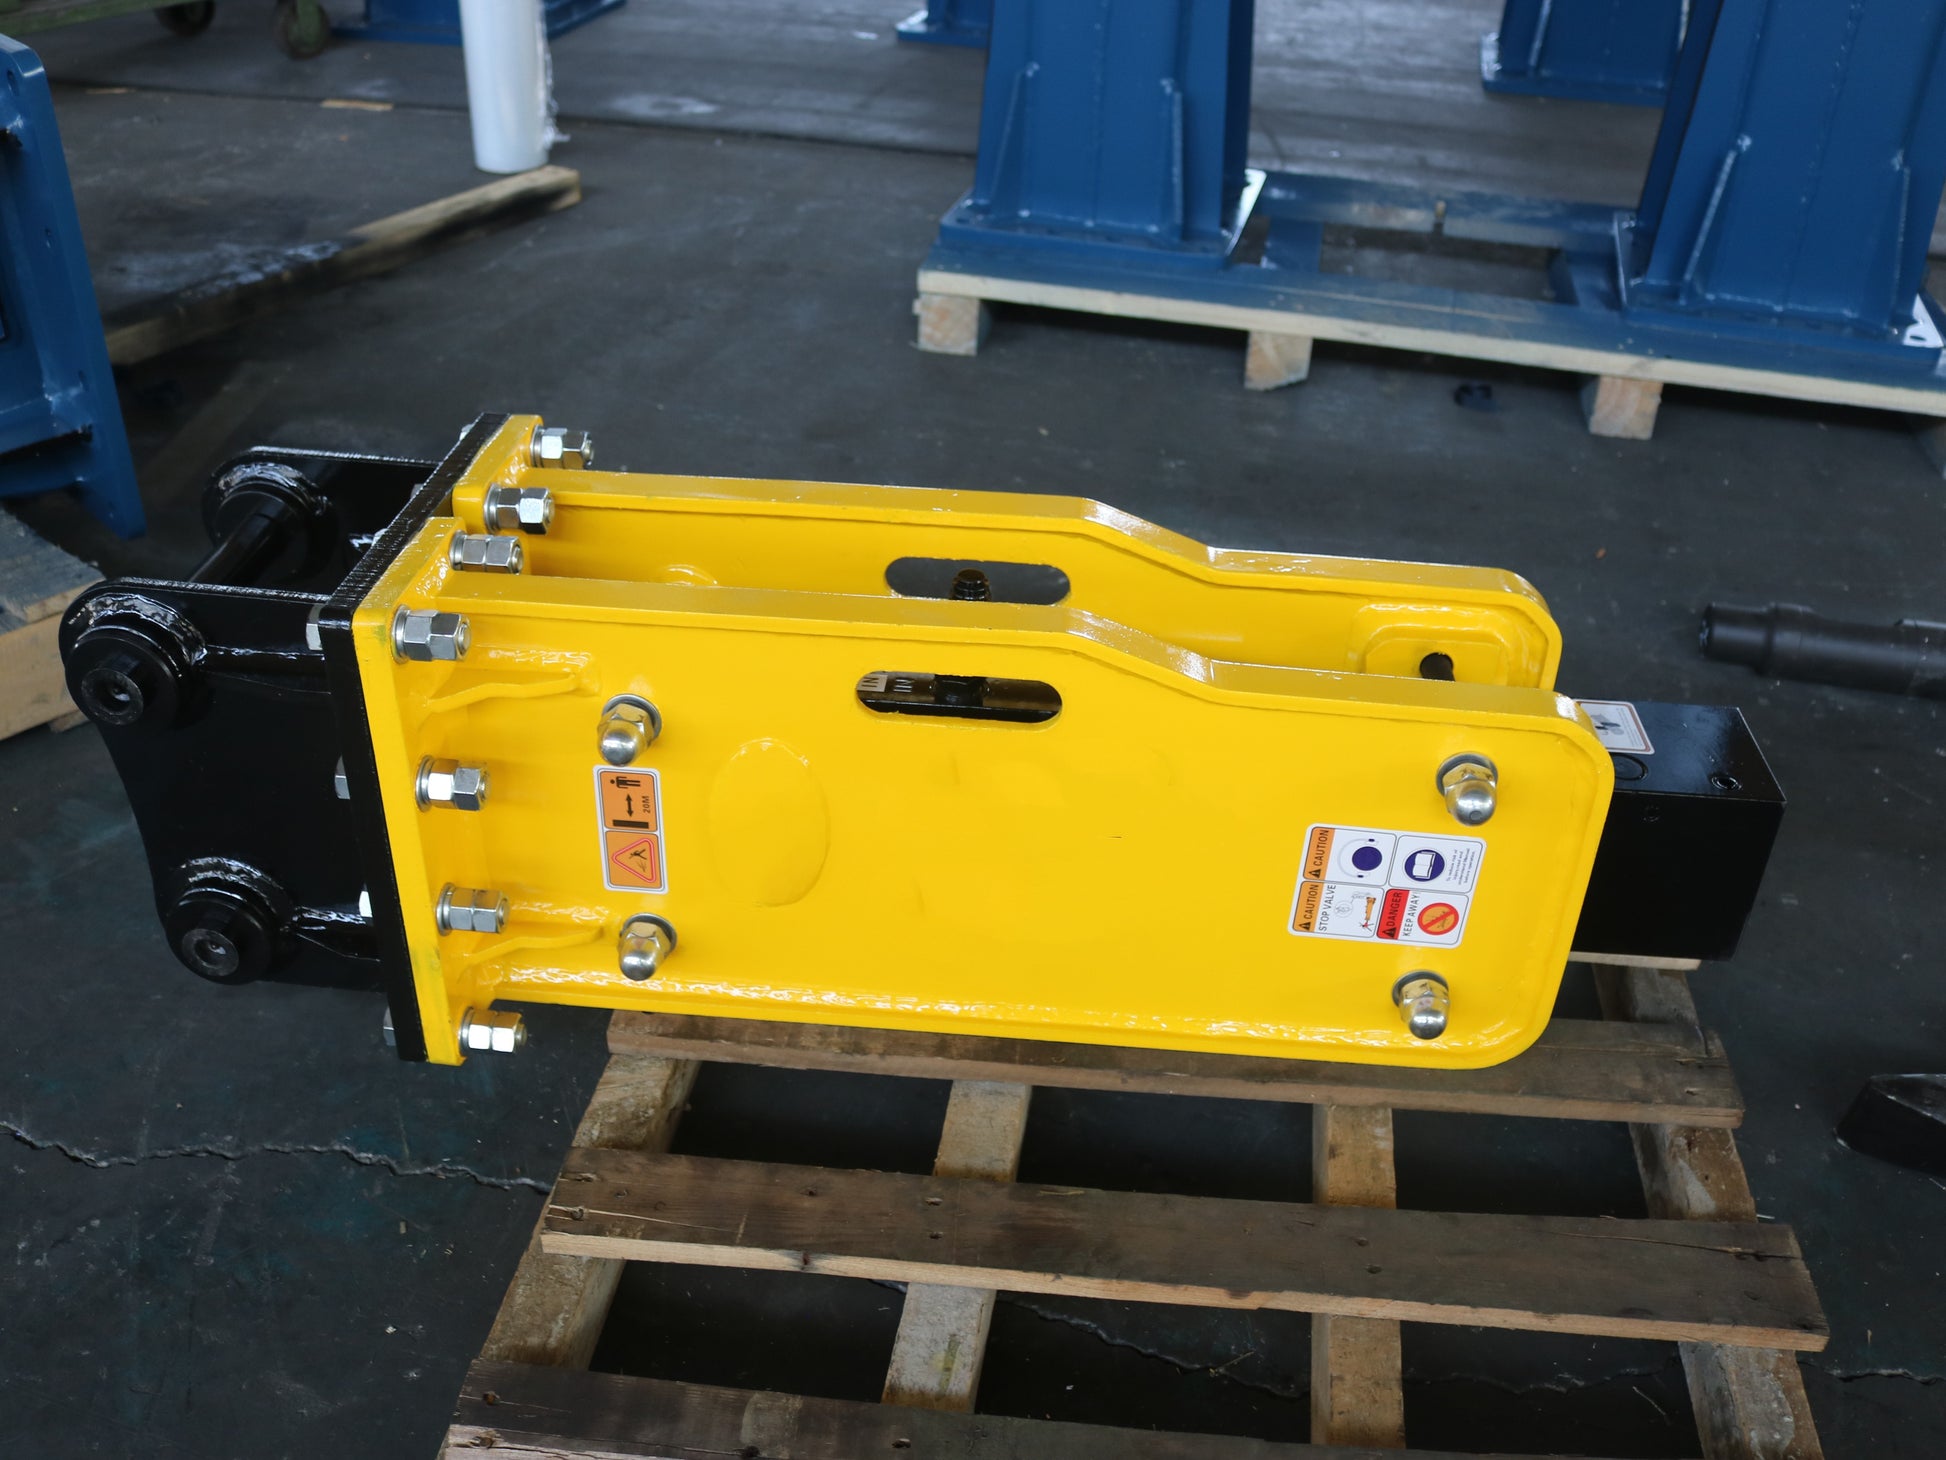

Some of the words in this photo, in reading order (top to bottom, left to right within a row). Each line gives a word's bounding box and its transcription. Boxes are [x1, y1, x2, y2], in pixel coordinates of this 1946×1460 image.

[641, 795, 651, 814] 20M
[1313, 829, 1329, 867] CAUTION
[1303, 884, 1319, 920] CAUTION
[1318, 910, 1330, 932] STOP
[1324, 884, 1337, 910] VALVE
[1386, 892, 1403, 927] DANGER
[1402, 918, 1413, 937] KEEP
